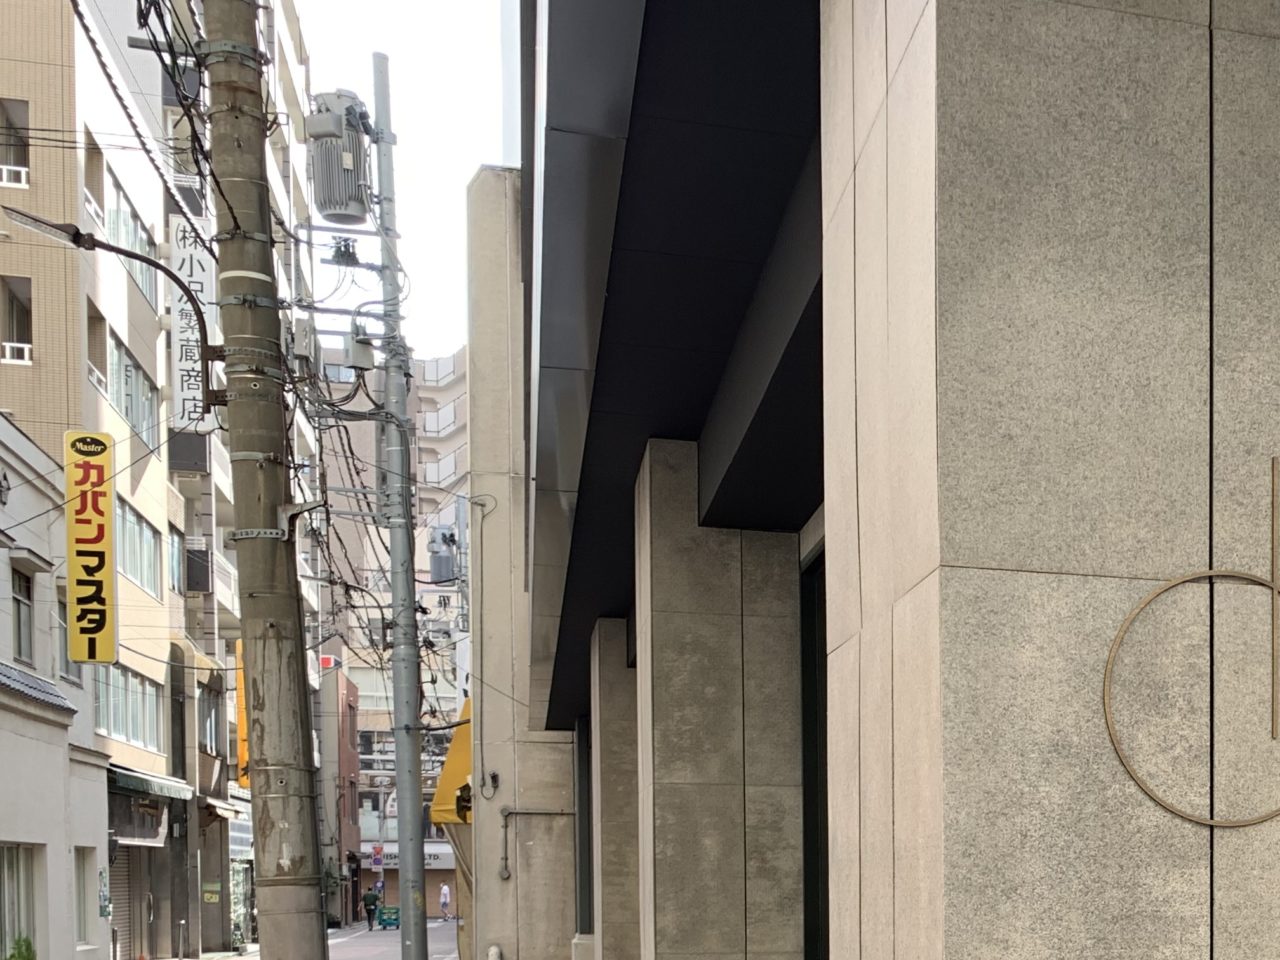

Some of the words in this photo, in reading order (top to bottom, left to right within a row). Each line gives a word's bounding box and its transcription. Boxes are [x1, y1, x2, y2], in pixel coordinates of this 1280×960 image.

[73, 441, 104, 452] Master
[75, 460, 107, 660] カバンマスター
